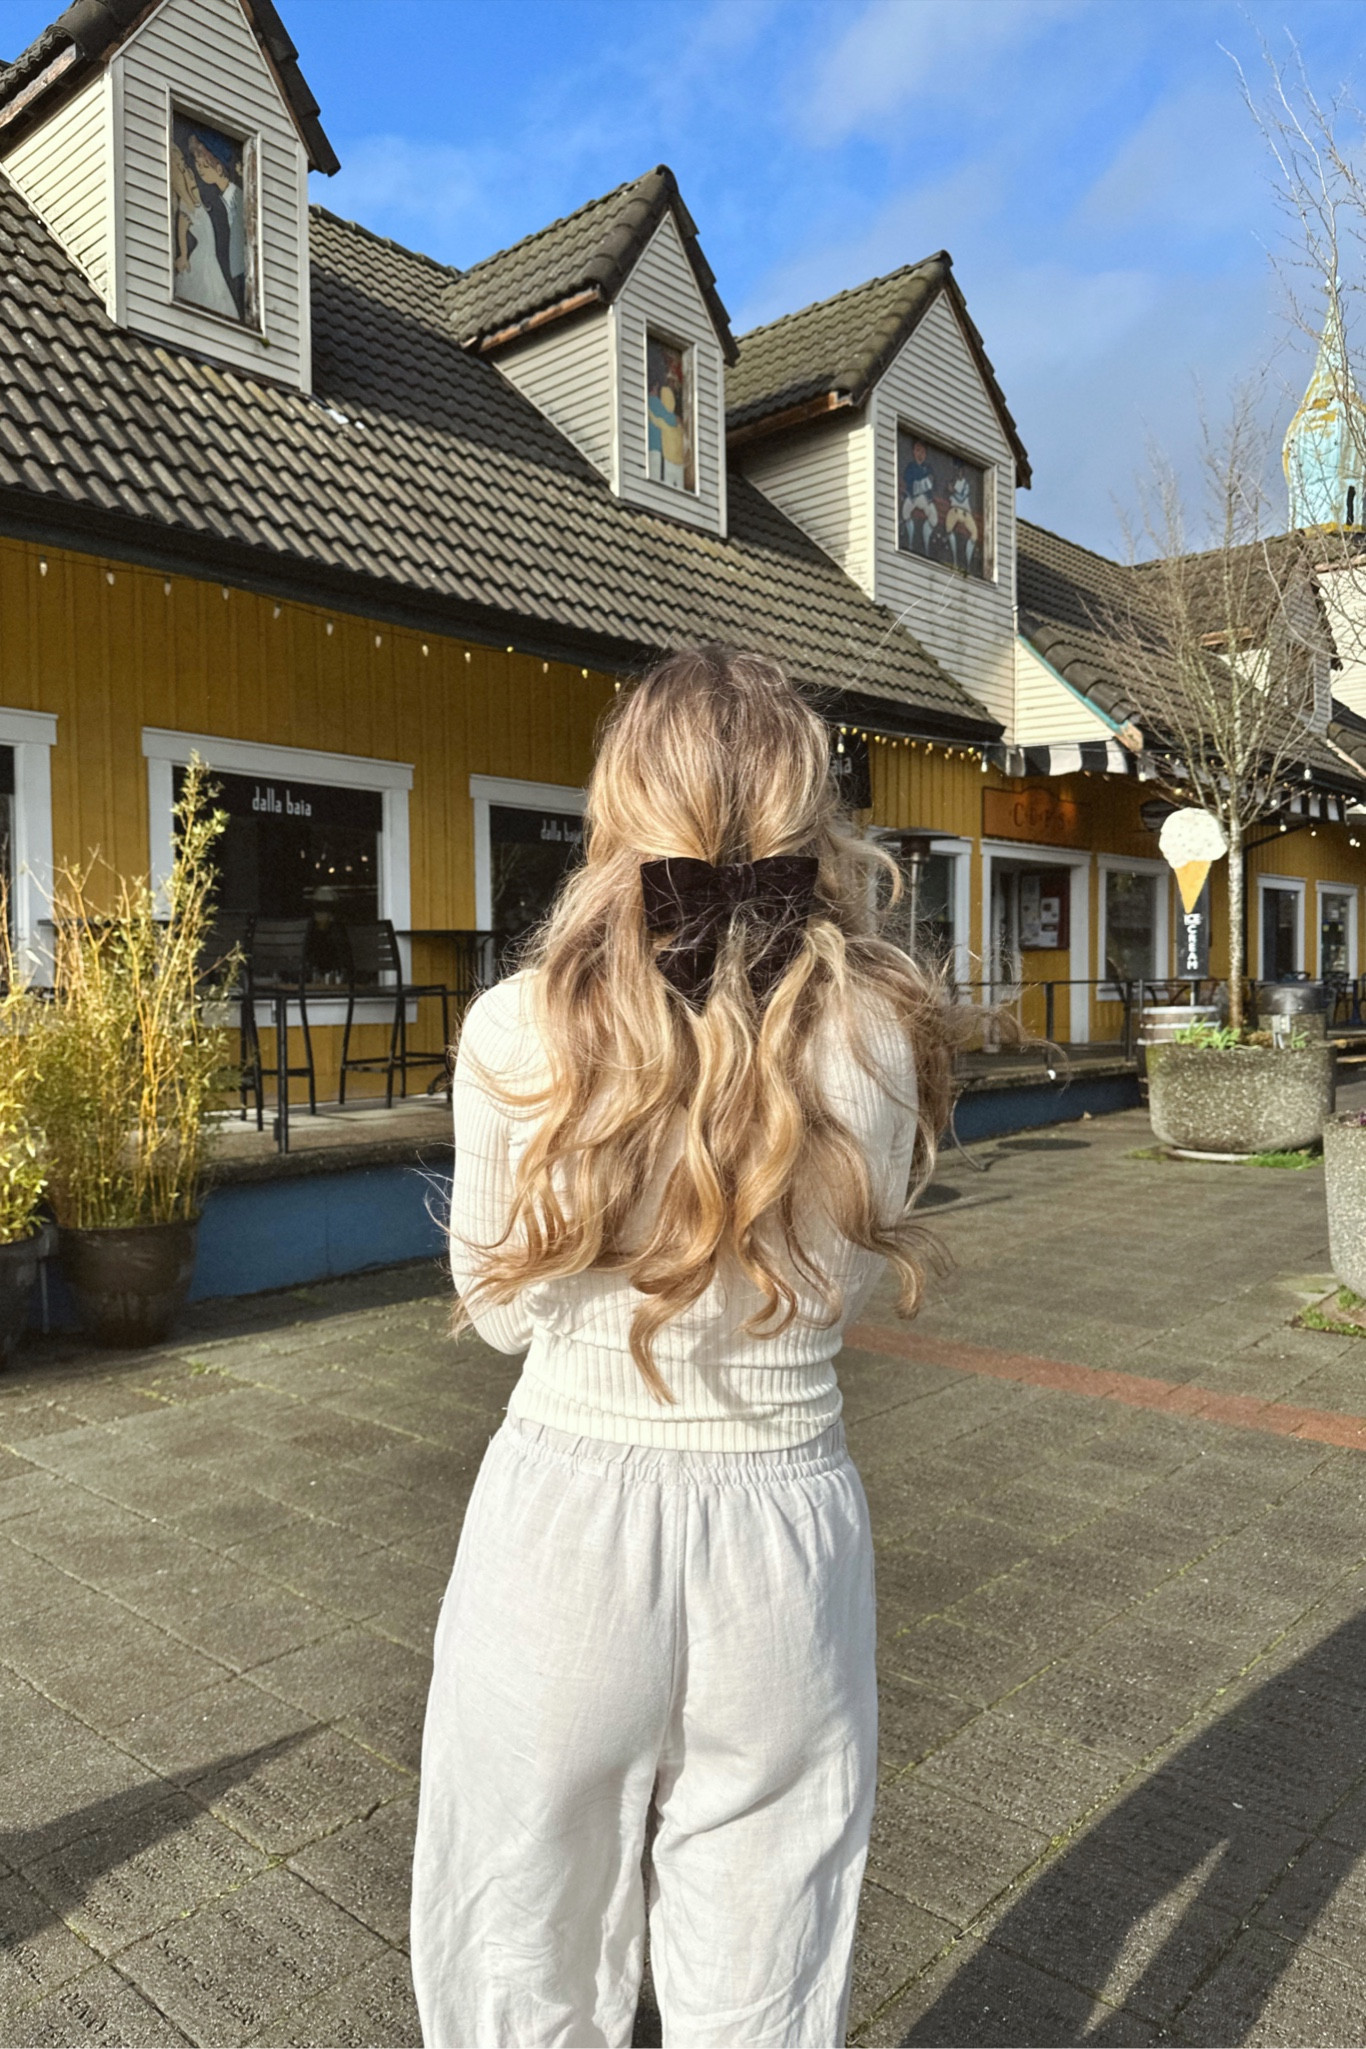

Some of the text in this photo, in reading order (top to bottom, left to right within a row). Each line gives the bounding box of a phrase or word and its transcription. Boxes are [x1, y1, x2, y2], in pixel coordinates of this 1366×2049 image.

[252, 786, 312, 817] dalla baia
[1183, 913, 1201, 926] ICE
[1186, 924, 1199, 970] CREAM
